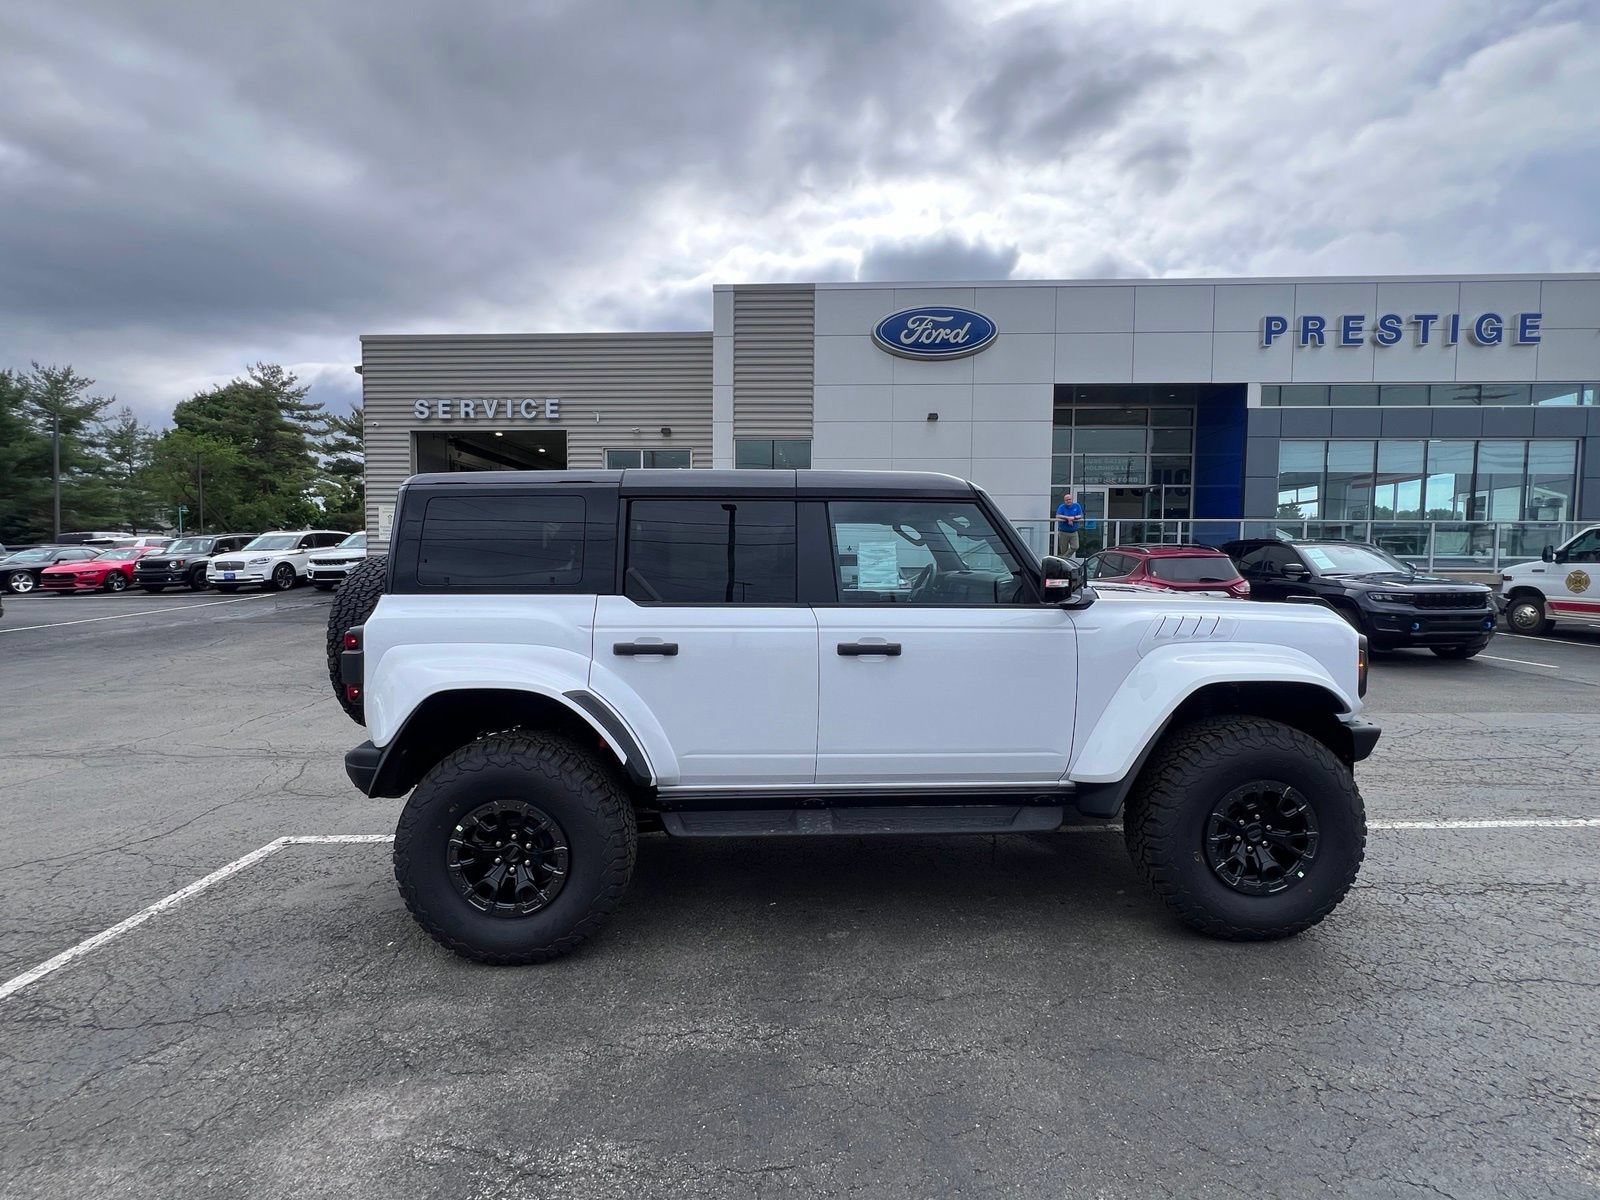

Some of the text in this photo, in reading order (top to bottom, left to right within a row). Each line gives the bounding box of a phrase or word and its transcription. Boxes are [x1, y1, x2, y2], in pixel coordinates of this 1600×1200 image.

[900, 315, 971, 344] Ford
[1263, 313, 1542, 346] PRESTIGE
[414, 399, 560, 419] SERVICE
